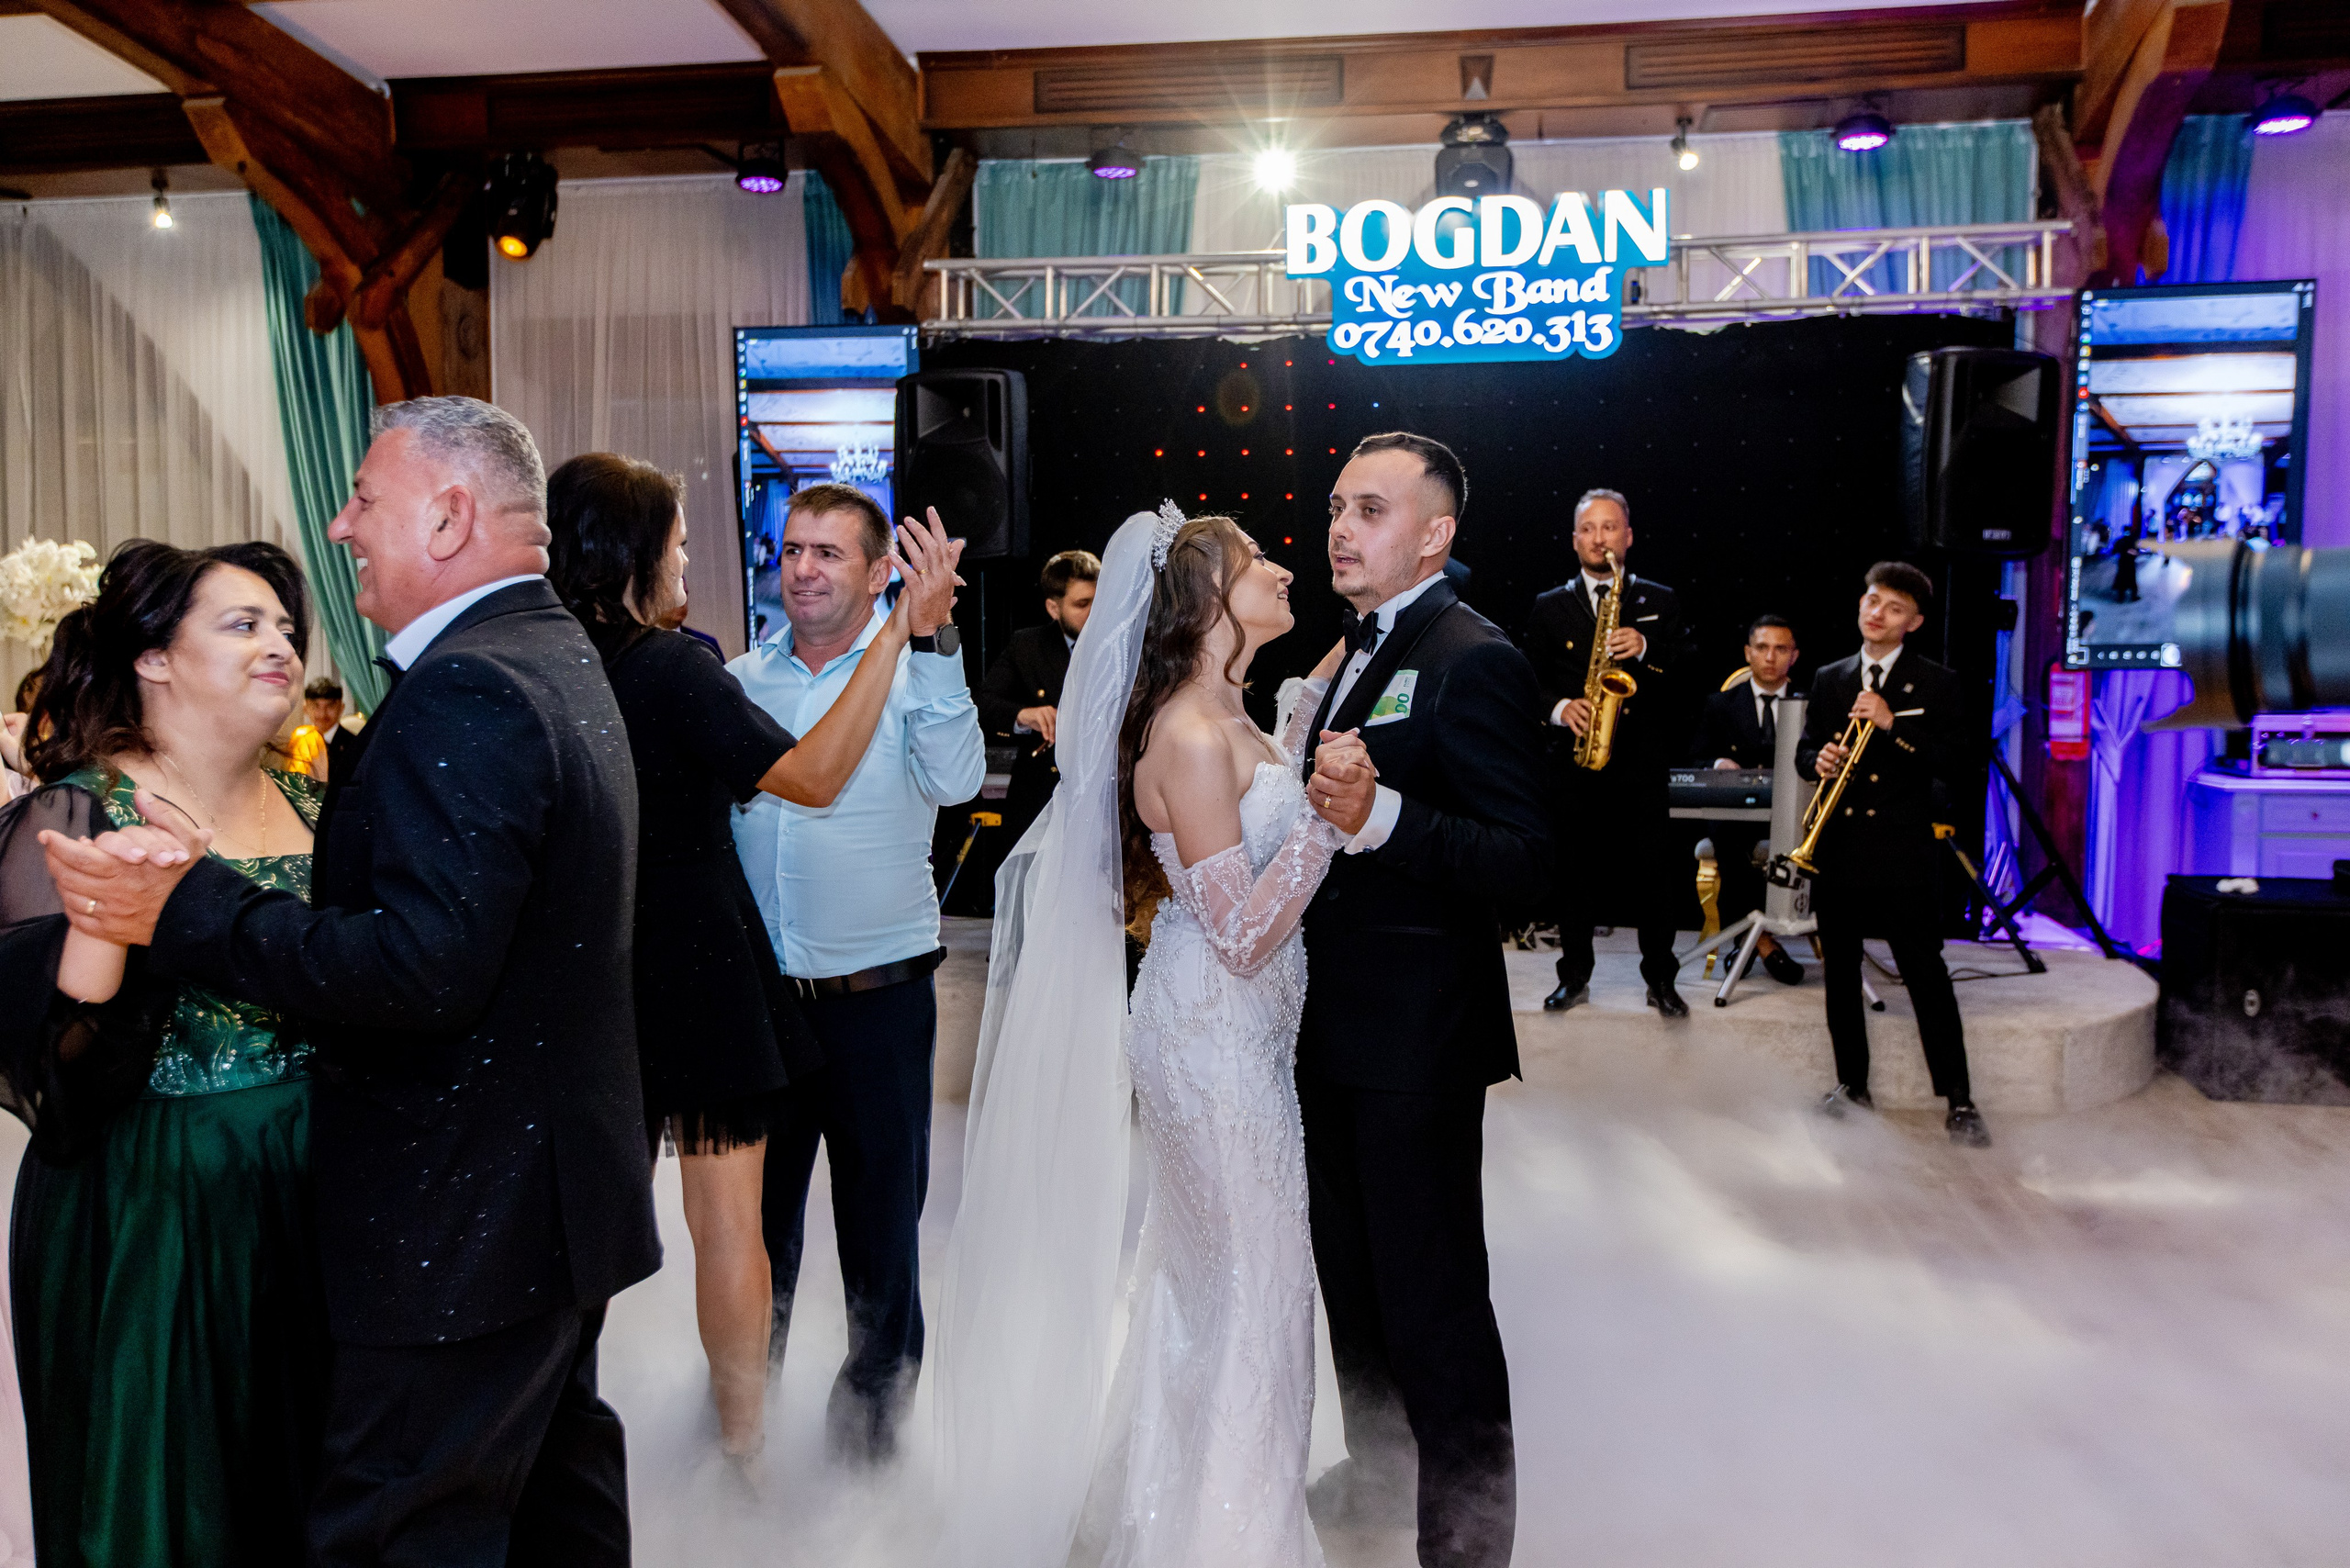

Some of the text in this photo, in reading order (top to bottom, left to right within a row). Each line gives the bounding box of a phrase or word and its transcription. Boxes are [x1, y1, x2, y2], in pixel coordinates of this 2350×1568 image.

[1286, 187, 1667, 274] BOGDAN
[1344, 266, 1614, 319] New Band
[1333, 308, 1614, 358] 0740.620.313
